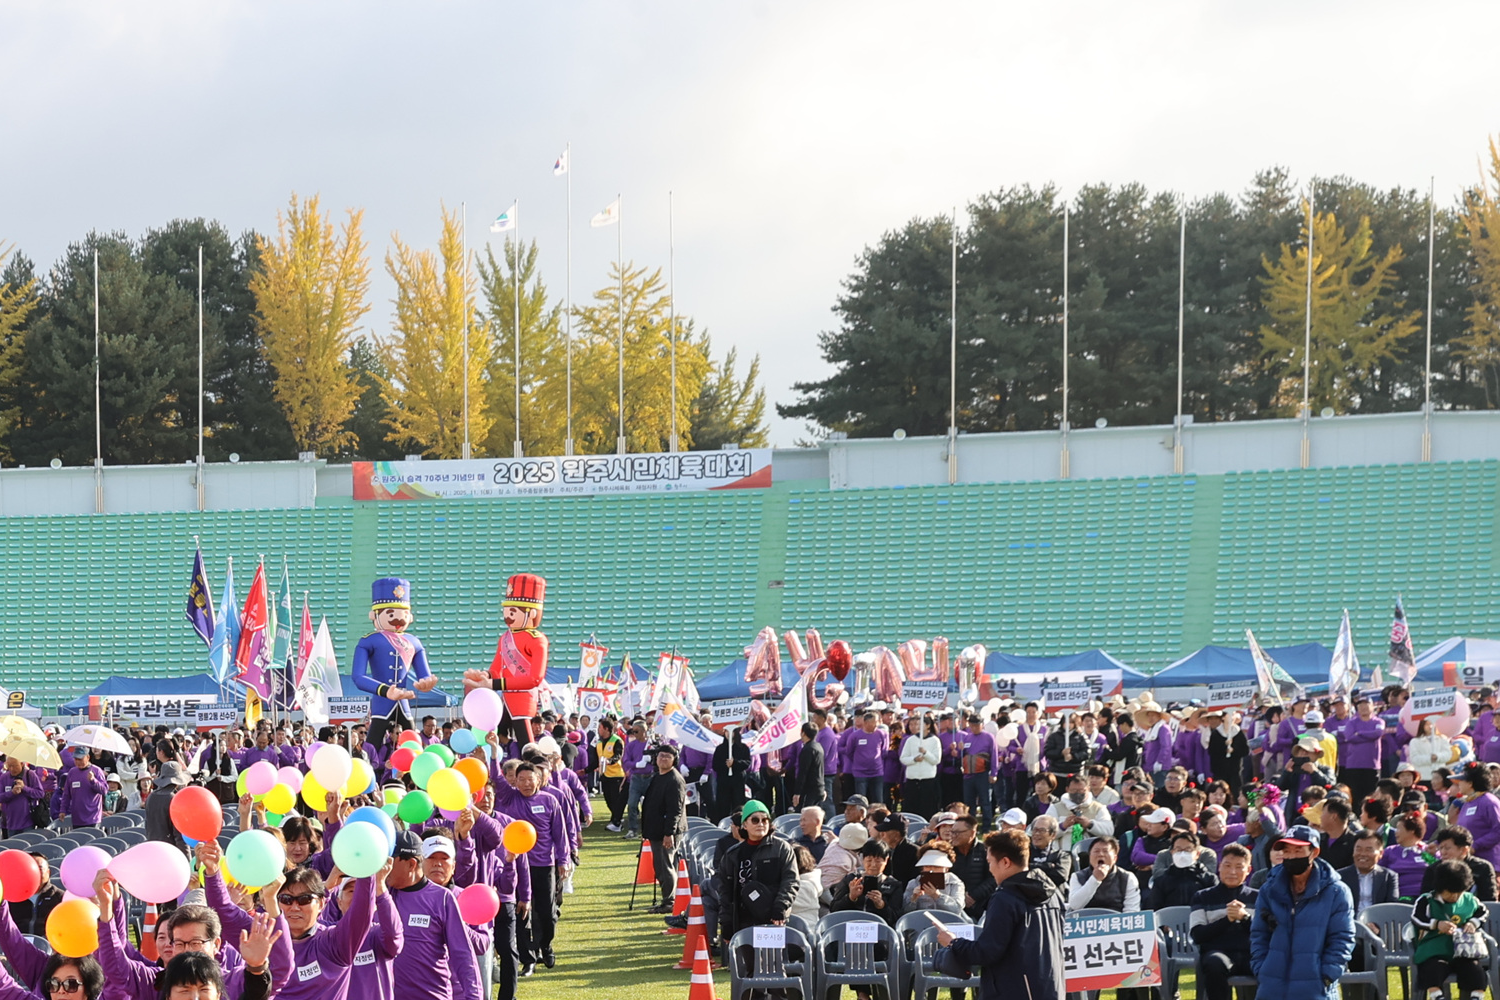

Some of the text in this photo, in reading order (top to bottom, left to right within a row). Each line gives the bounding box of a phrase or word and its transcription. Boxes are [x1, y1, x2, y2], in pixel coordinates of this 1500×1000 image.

[493, 452, 752, 484] 2025 원주시민체육대회
[381, 475, 404, 484] 원주시
[406, 475, 422, 483] 승격
[425, 474, 449, 482] 70주년
[925, 690, 944, 699] 선수단
[1068, 691, 1088, 700] 선수단
[350, 705, 368, 714] 선수단
[733, 706, 750, 716] 선수단
[220, 712, 235, 720] 선수단
[1064, 914, 1145, 937] 주시민체육대회
[1083, 939, 1144, 969] 선수단
[299, 965, 319, 978] 지정면
